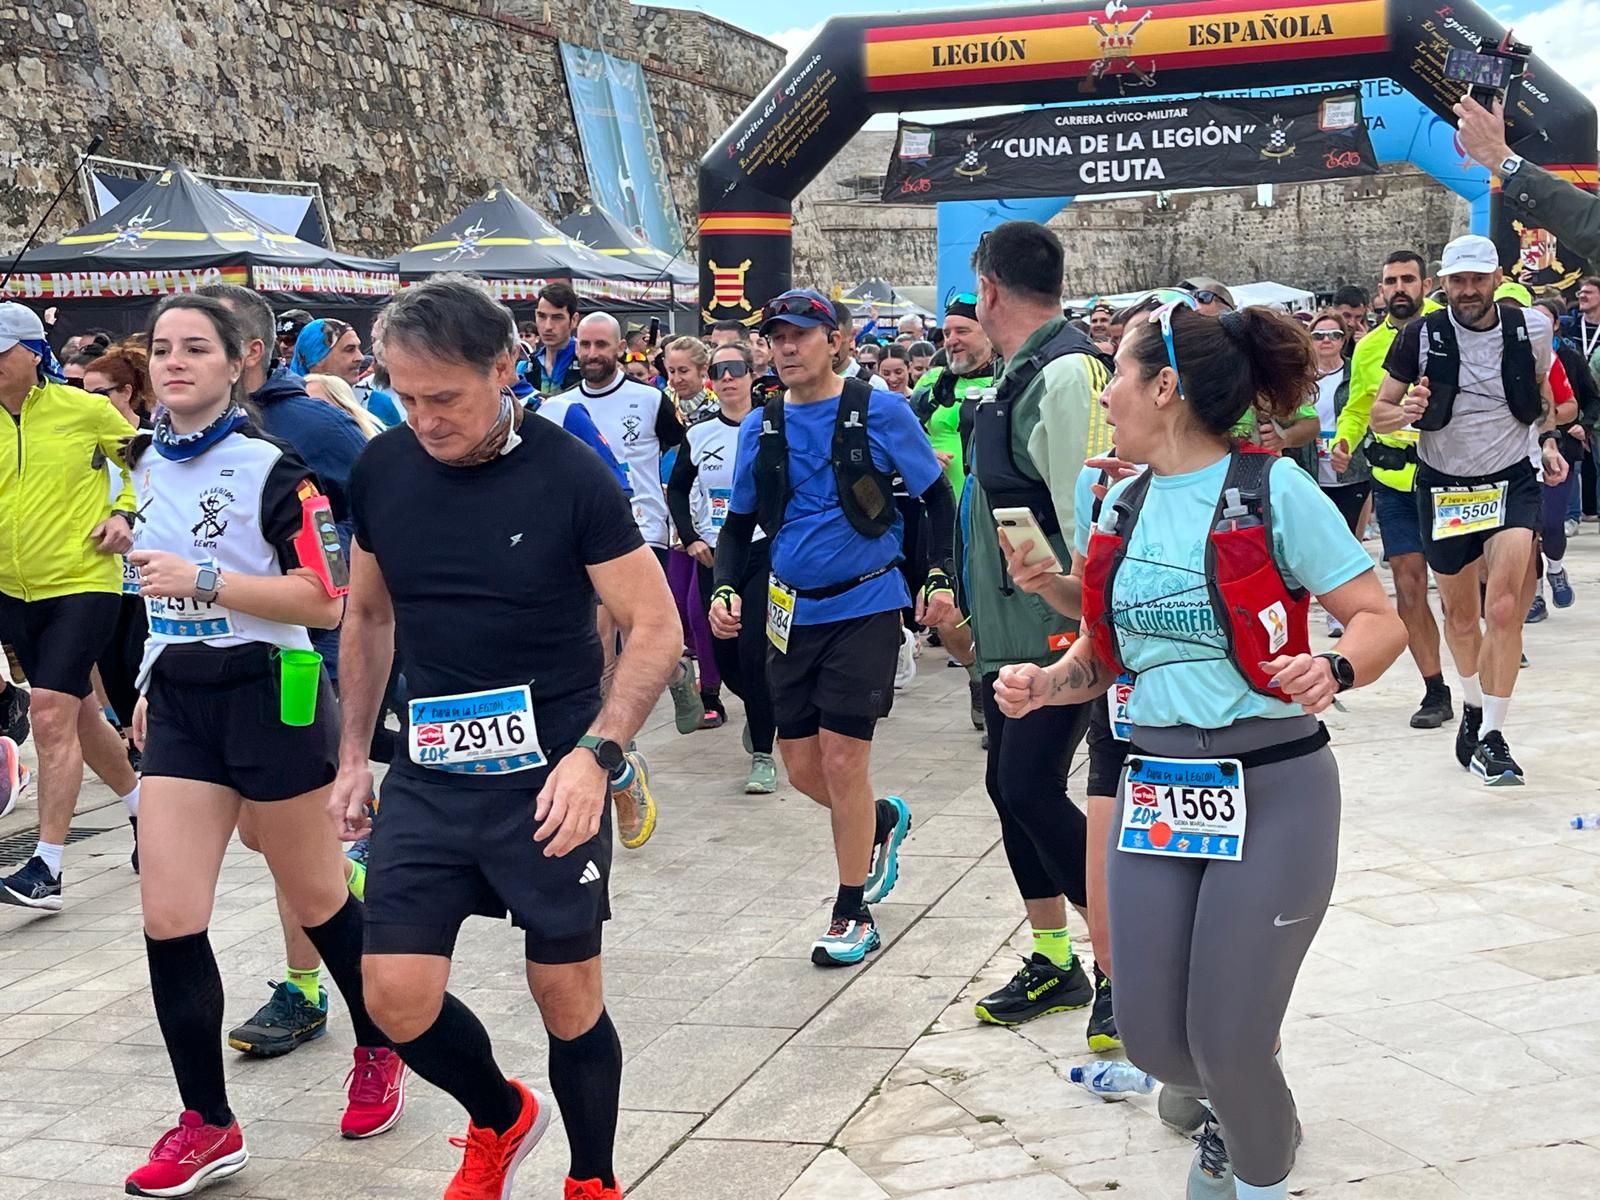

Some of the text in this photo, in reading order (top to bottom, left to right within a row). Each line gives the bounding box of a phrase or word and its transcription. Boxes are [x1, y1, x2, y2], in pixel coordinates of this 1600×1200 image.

[932, 14, 1334, 67] LEGIÓN ESPAÑOLA
[1055, 108, 1188, 126] CARRERA CÍVICO-MILITAR
[1080, 134, 1108, 154] DE
[1116, 132, 1145, 152] LA
[1079, 157, 1166, 184] CEUTA
[51, 267, 223, 297] DEPORTIVO
[1461, 501, 1498, 520] 5500
[1135, 608, 1218, 633] GUERRER
[450, 715, 525, 752] 2916
[419, 747, 450, 762] 20K
[1131, 806, 1161, 825] 20K
[1164, 787, 1235, 822] 1563
